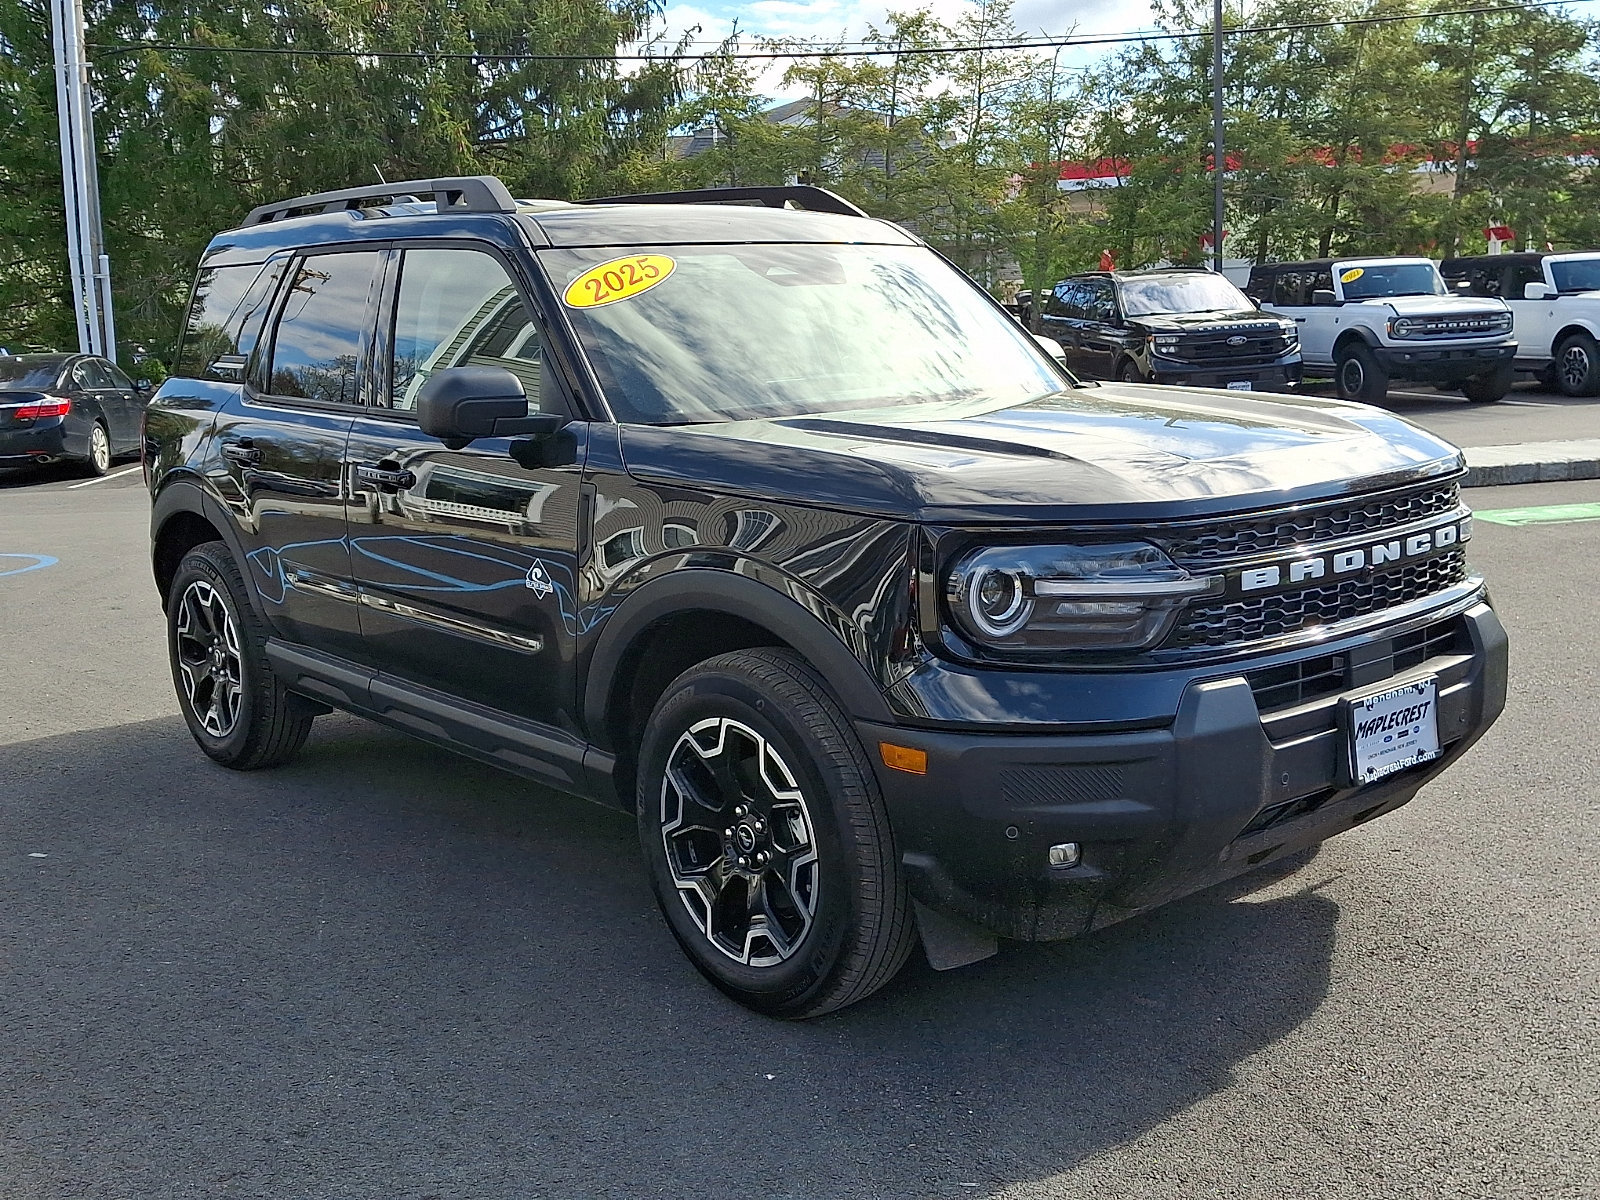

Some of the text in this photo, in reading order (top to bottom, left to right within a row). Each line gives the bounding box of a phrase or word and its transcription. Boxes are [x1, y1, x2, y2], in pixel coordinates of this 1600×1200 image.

[585, 258, 659, 302] 2025
[1198, 323, 1270, 331] EXPEDITION
[1427, 321, 1489, 329] BRONCO
[1241, 525, 1457, 591] BRONCO
[1355, 701, 1431, 740] MAPLECREST
